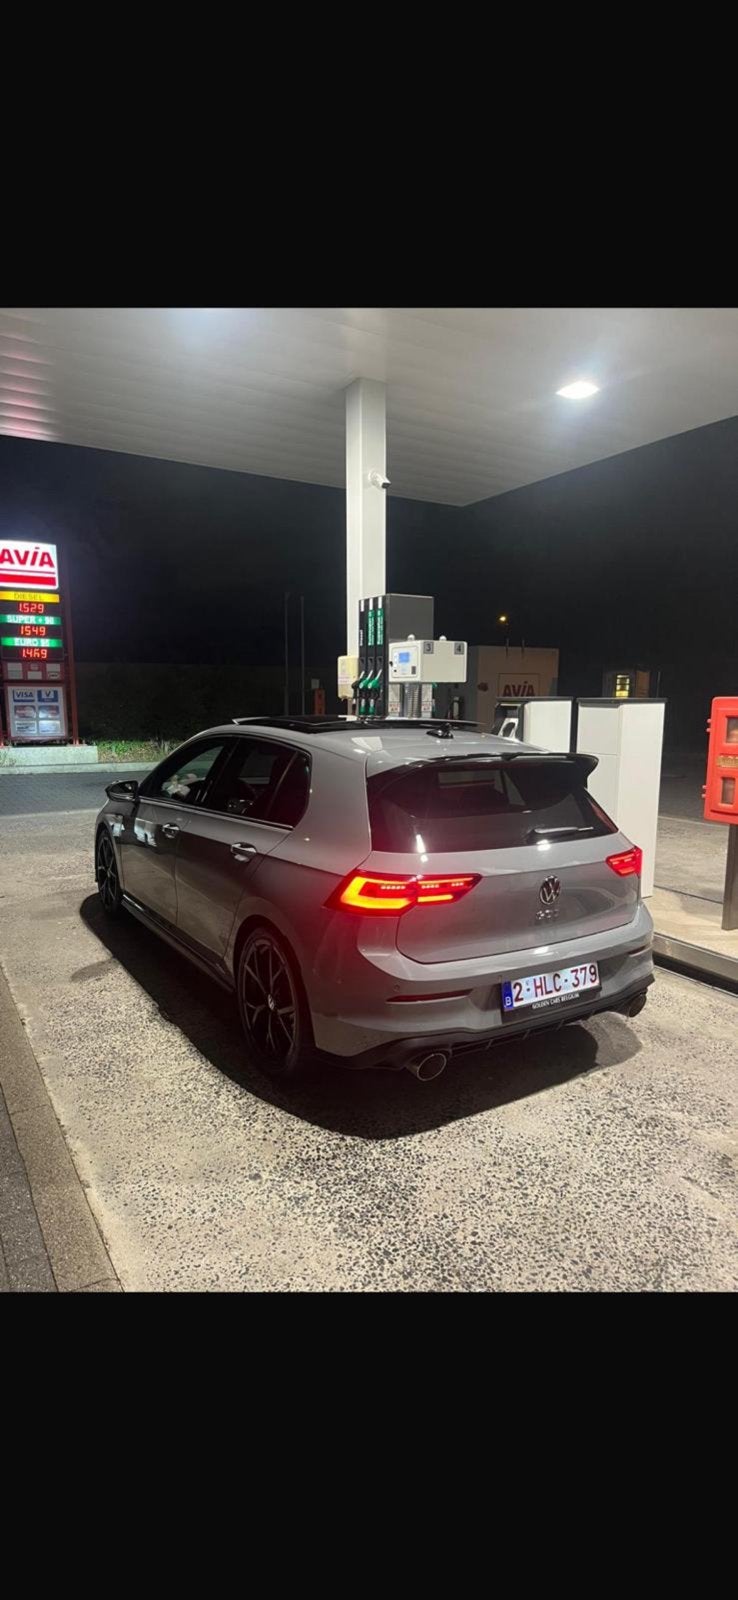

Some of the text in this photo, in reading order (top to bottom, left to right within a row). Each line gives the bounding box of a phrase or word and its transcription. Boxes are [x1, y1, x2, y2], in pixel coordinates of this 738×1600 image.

[14, 592, 43, 601] DIESEL
[6, 614, 35, 624] SUPER
[14, 638, 38, 647] EURO
[505, 996, 512, 1006] B
[532, 1001, 550, 1010] GOLDEN
[561, 992, 580, 1002] BELGIUM
